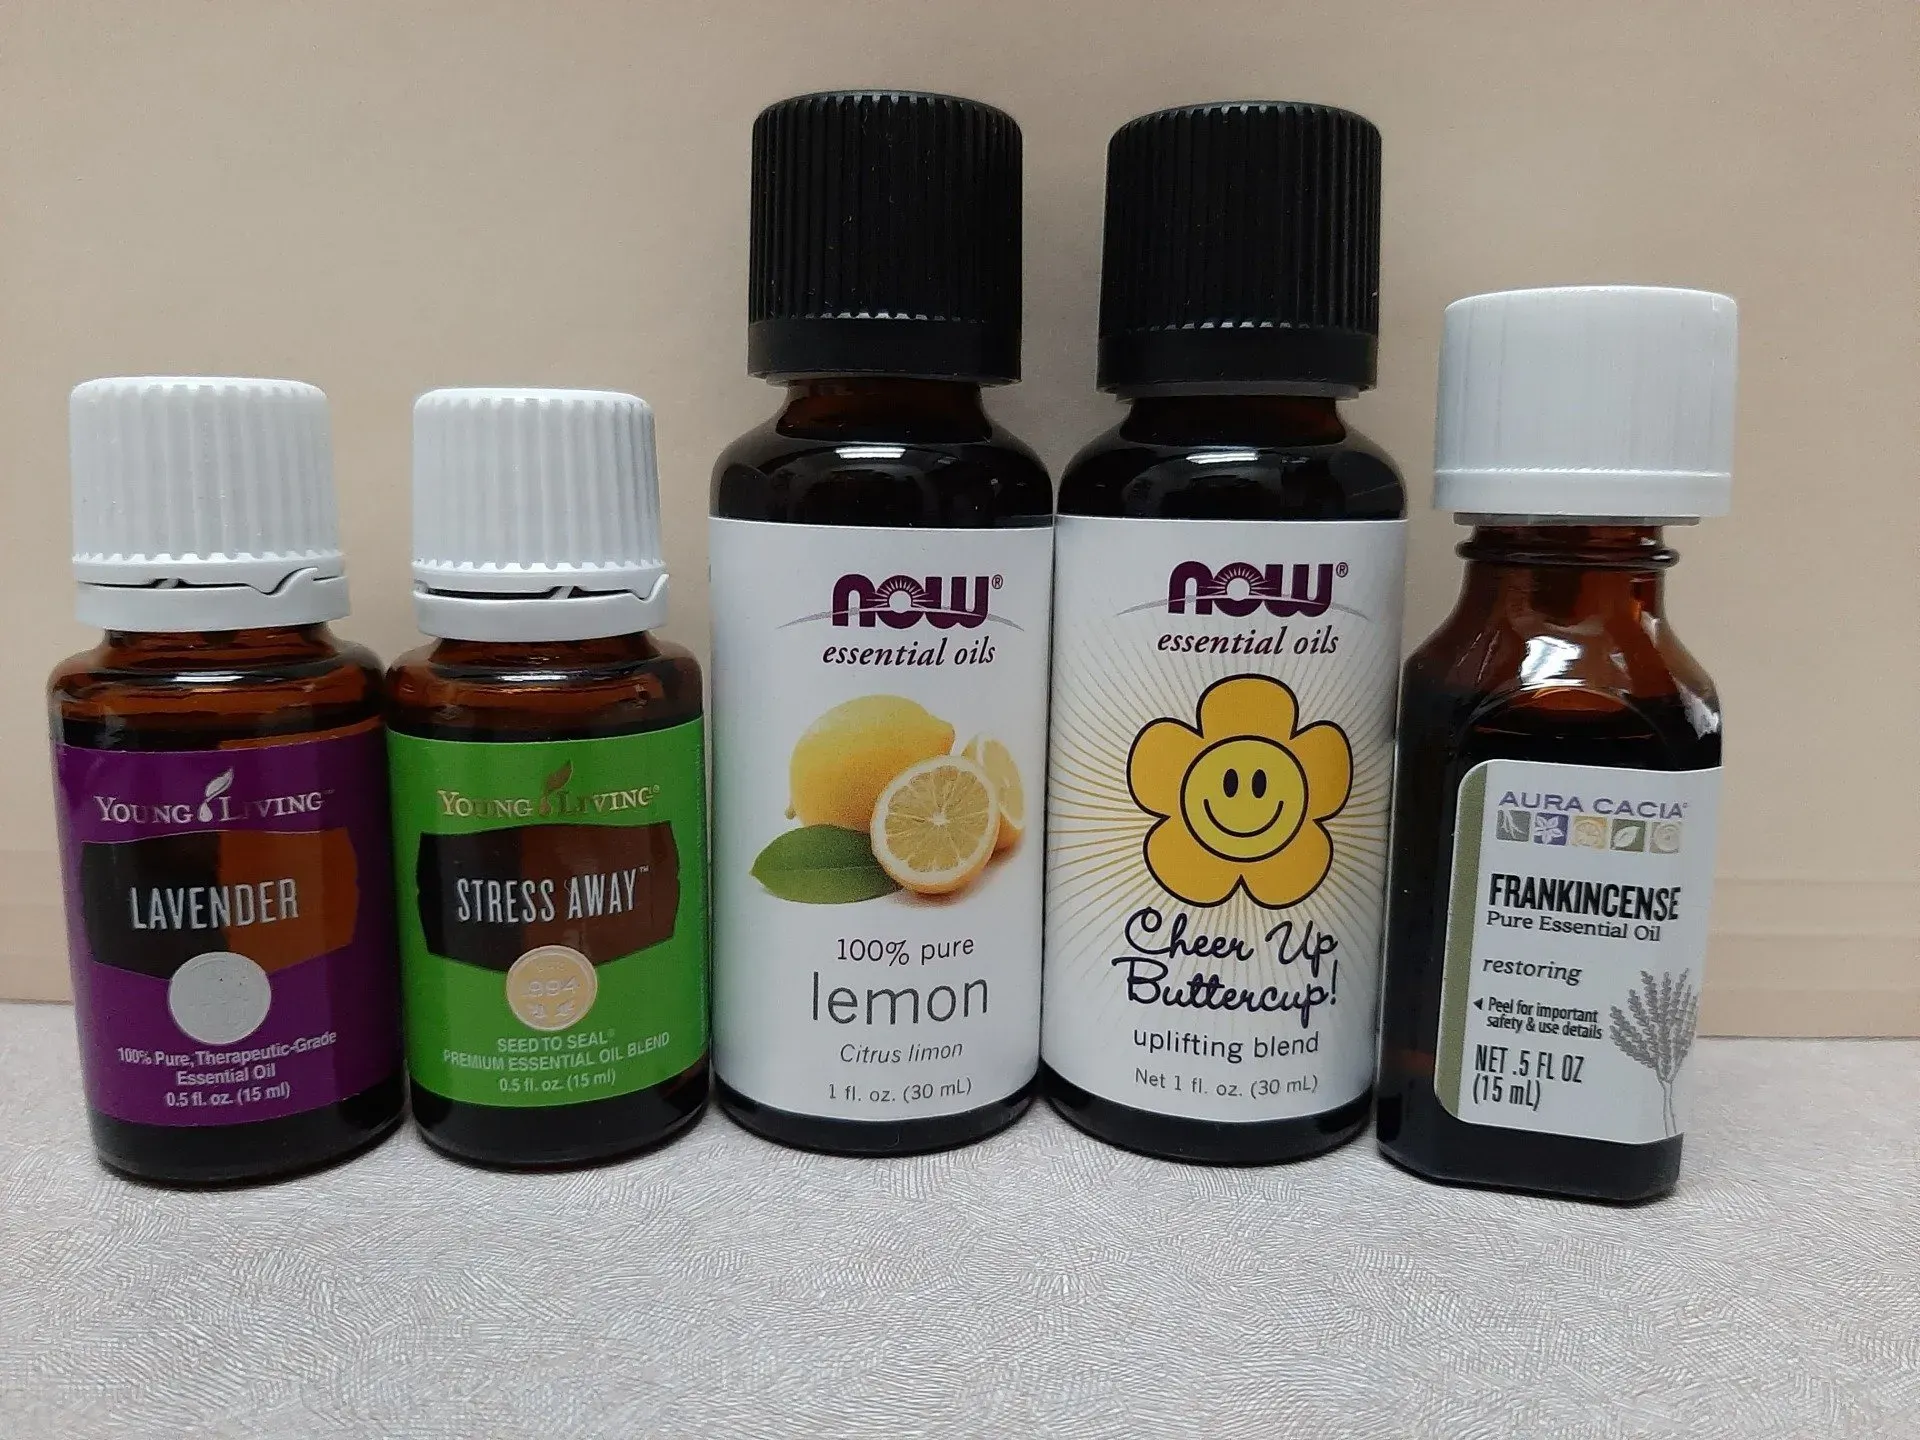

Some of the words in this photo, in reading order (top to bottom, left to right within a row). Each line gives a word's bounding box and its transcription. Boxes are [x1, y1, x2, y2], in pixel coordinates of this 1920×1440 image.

[822, 637, 945, 667] essential
[953, 635, 997, 665] oils
[1157, 626, 1288, 656] essential
[1293, 624, 1340, 655] oils
[93, 794, 194, 824] YOUNG
[436, 789, 534, 819] YOUNG
[1498, 790, 1585, 814] AURA
[1592, 797, 1683, 820] CACIA
[129, 877, 300, 931] LAVENDER
[455, 876, 556, 924] STRESS
[566, 867, 637, 921] AWAY
[1488, 872, 1682, 923] FRANKINCENSE
[1485, 910, 1534, 930] Pure
[1538, 916, 1629, 940] Essential
[1633, 924, 1662, 942] Oil
[836, 938, 910, 967] 100%
[920, 937, 975, 966] pure
[1124, 906, 1255, 962] Cheer
[1264, 919, 1340, 979] Up
[1481, 957, 1583, 987] restoring
[811, 970, 989, 1026] lemon
[1111, 955, 1339, 1029] Buttercup!
[1487, 996, 1514, 1015] Peel
[1515, 999, 1534, 1017] for
[1535, 1001, 1599, 1024] important
[497, 1037, 539, 1054] SEED
[541, 1036, 563, 1053] TO
[566, 1031, 609, 1051] SEAL
[1486, 1013, 1524, 1035] safety
[1525, 1018, 1536, 1033] &
[1538, 1022, 1560, 1035] use
[1562, 1021, 1603, 1040] details
[117, 1047, 152, 1066] 100%
[155, 1050, 195, 1068] Pure,
[195, 1030, 338, 1067] Therapeutic-Grade
[443, 1049, 505, 1071] PREMIUM
[507, 1052, 596, 1072] ESSENTIAL
[599, 1048, 625, 1065] OIL
[626, 1031, 670, 1058] BLEND
[839, 1043, 902, 1064] Citrus
[908, 1042, 963, 1063] limon
[1133, 1028, 1245, 1064] uplifting
[1253, 1031, 1320, 1059] blend
[176, 1067, 250, 1086] Essential
[252, 1062, 277, 1080] Oil
[1474, 1043, 1509, 1074] NET
[1511, 1050, 1531, 1078] .5
[1535, 1052, 1555, 1081] FL
[1560, 1054, 1586, 1084] OZ
[165, 1091, 189, 1107] 0.5
[190, 1090, 207, 1107] fl.
[211, 1092, 234, 1107] oz.
[236, 1087, 262, 1106] (15
[265, 1081, 292, 1101] ml)
[499, 1077, 521, 1093] 0.5
[523, 1077, 538, 1092] fl.
[541, 1079, 564, 1092] oz.
[566, 1072, 590, 1092] (15
[593, 1067, 617, 1085] ml)
[828, 1083, 836, 1100] 1
[844, 1084, 862, 1102] fl.
[868, 1087, 897, 1102] oz.
[902, 1082, 934, 1104] (30
[938, 1076, 973, 1098] mL)
[1134, 1067, 1167, 1090] Net
[1173, 1075, 1182, 1092] 1
[1190, 1078, 1209, 1095] fl.
[1215, 1082, 1243, 1097] oz.
[1249, 1078, 1281, 1100] (30
[1285, 1074, 1319, 1094] mL)
[1471, 1073, 1504, 1105] (15
[1508, 1079, 1542, 1112] mL)
